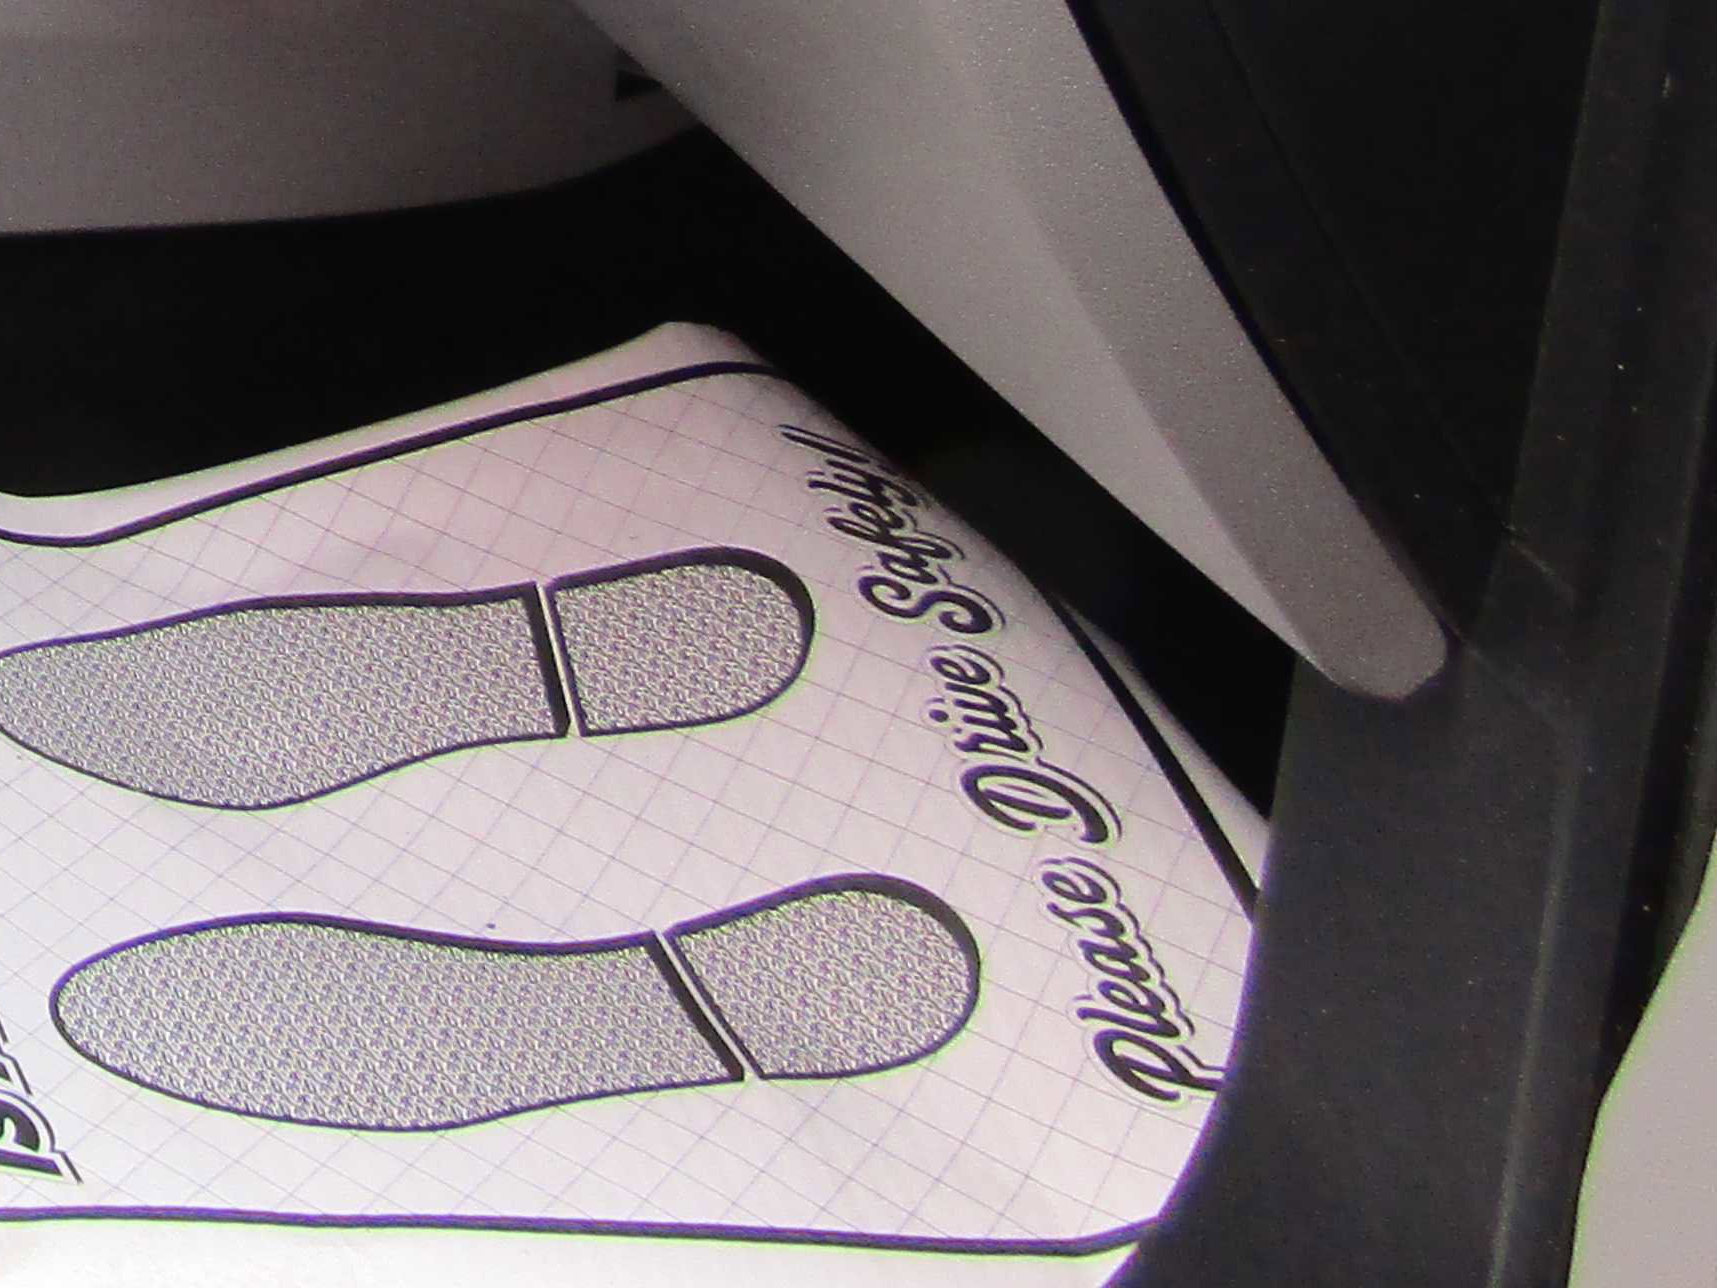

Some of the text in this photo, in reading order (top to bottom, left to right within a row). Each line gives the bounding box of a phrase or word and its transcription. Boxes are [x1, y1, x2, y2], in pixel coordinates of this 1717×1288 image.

[777, 423, 1227, 1105] Please Drive Safely!
